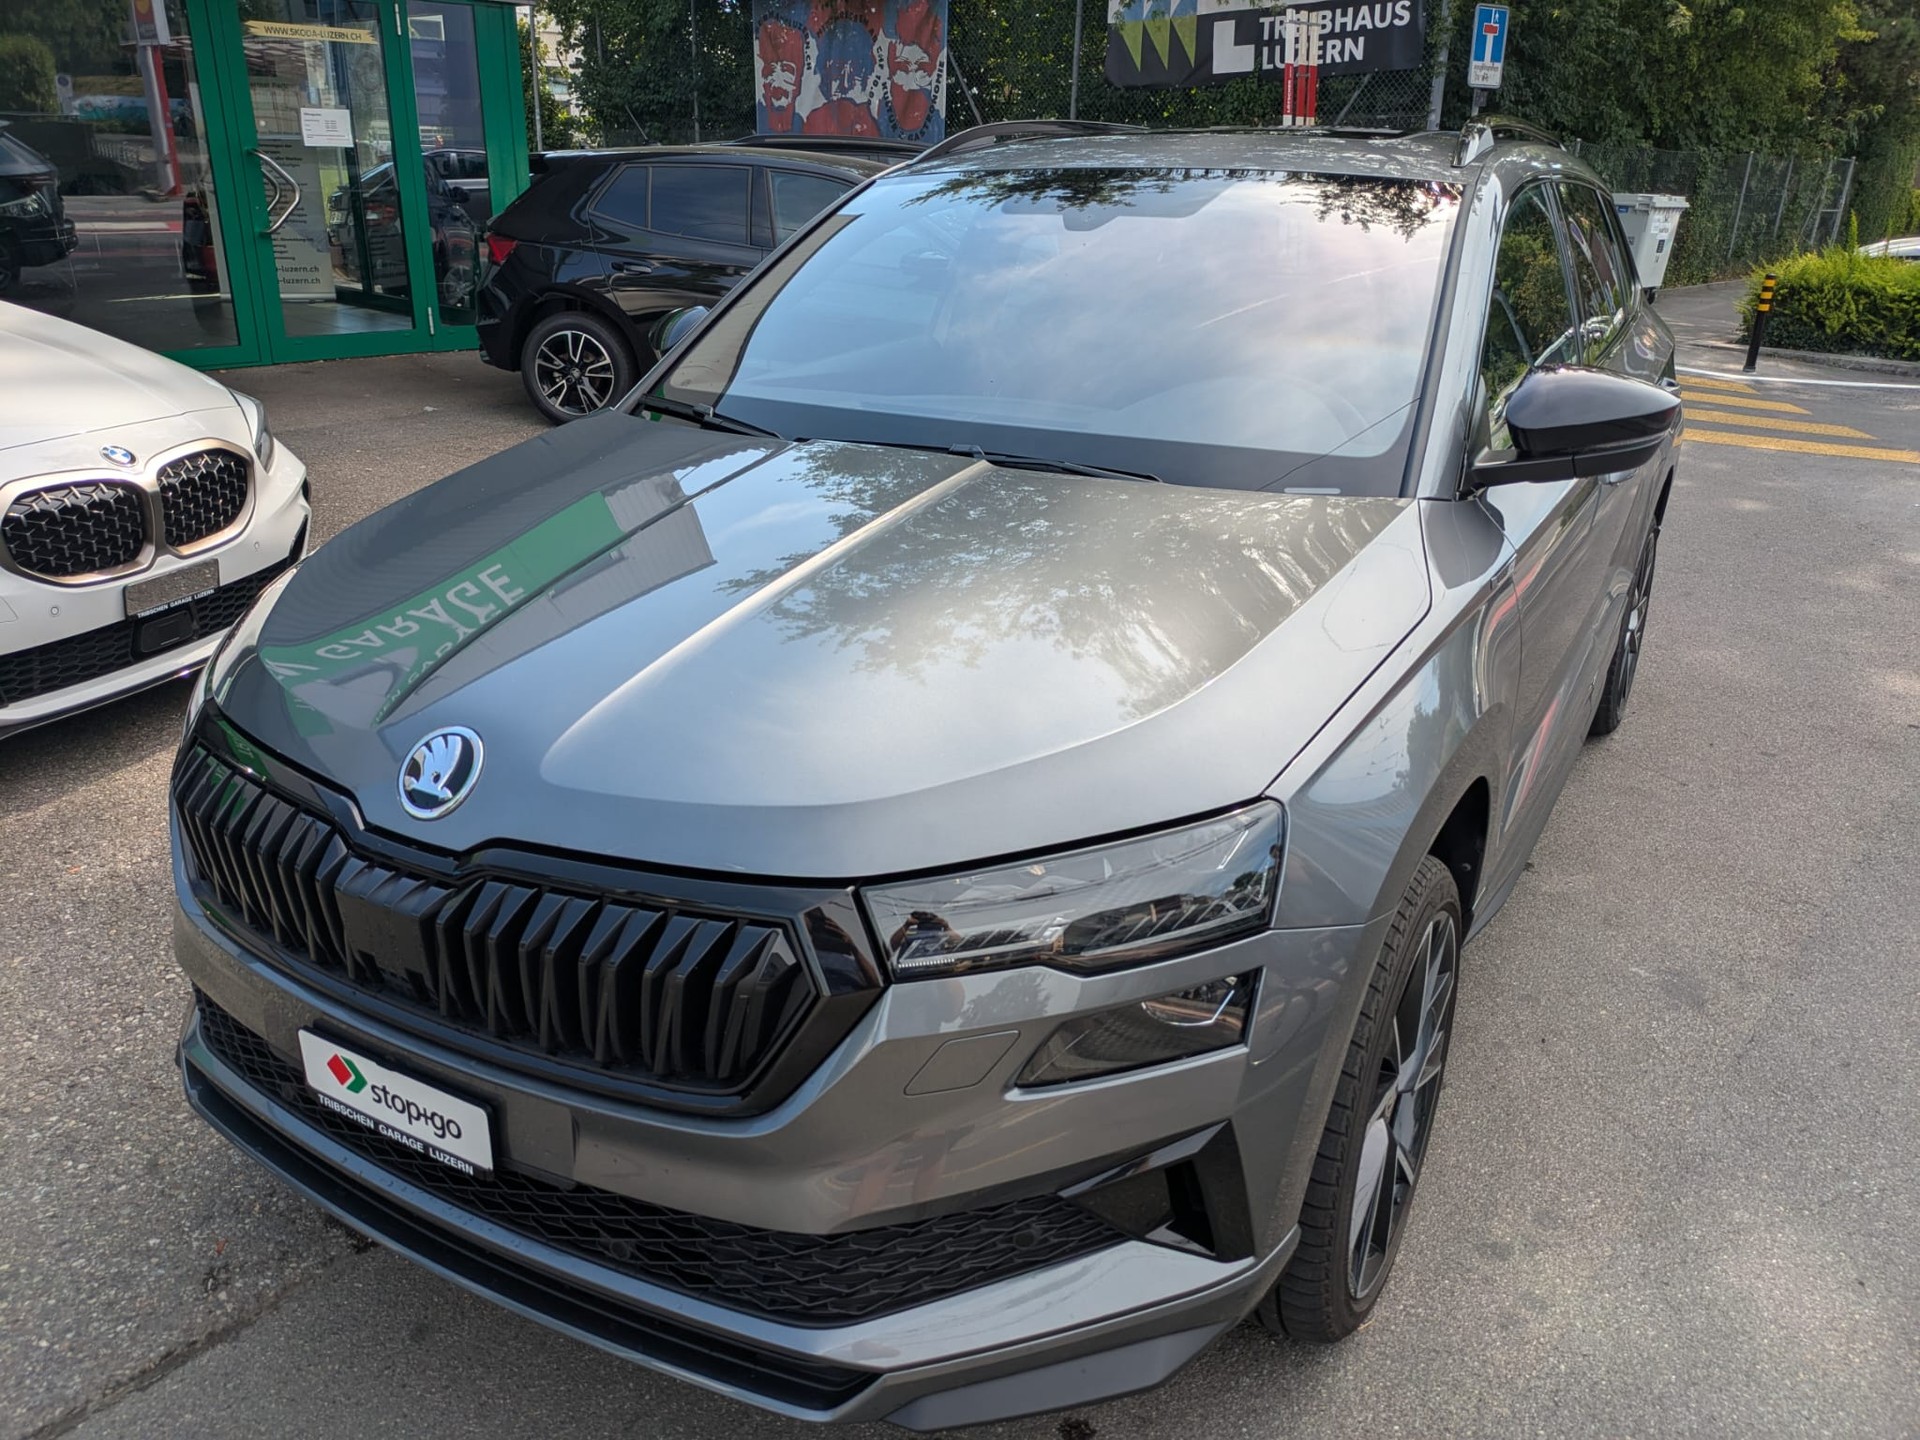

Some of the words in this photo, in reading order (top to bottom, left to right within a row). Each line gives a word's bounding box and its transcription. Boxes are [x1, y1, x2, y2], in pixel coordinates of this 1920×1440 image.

[1259, 0, 1411, 41] TRBHAUS
[169, 596, 192, 608] GARAGE
[194, 588, 215, 600] LUZERN
[317, 1093, 374, 1129] TRIBSCHEN
[378, 1123, 424, 1152] GARAGE
[429, 1147, 474, 1176] LUZERN
[370, 1082, 462, 1140] stop+go
